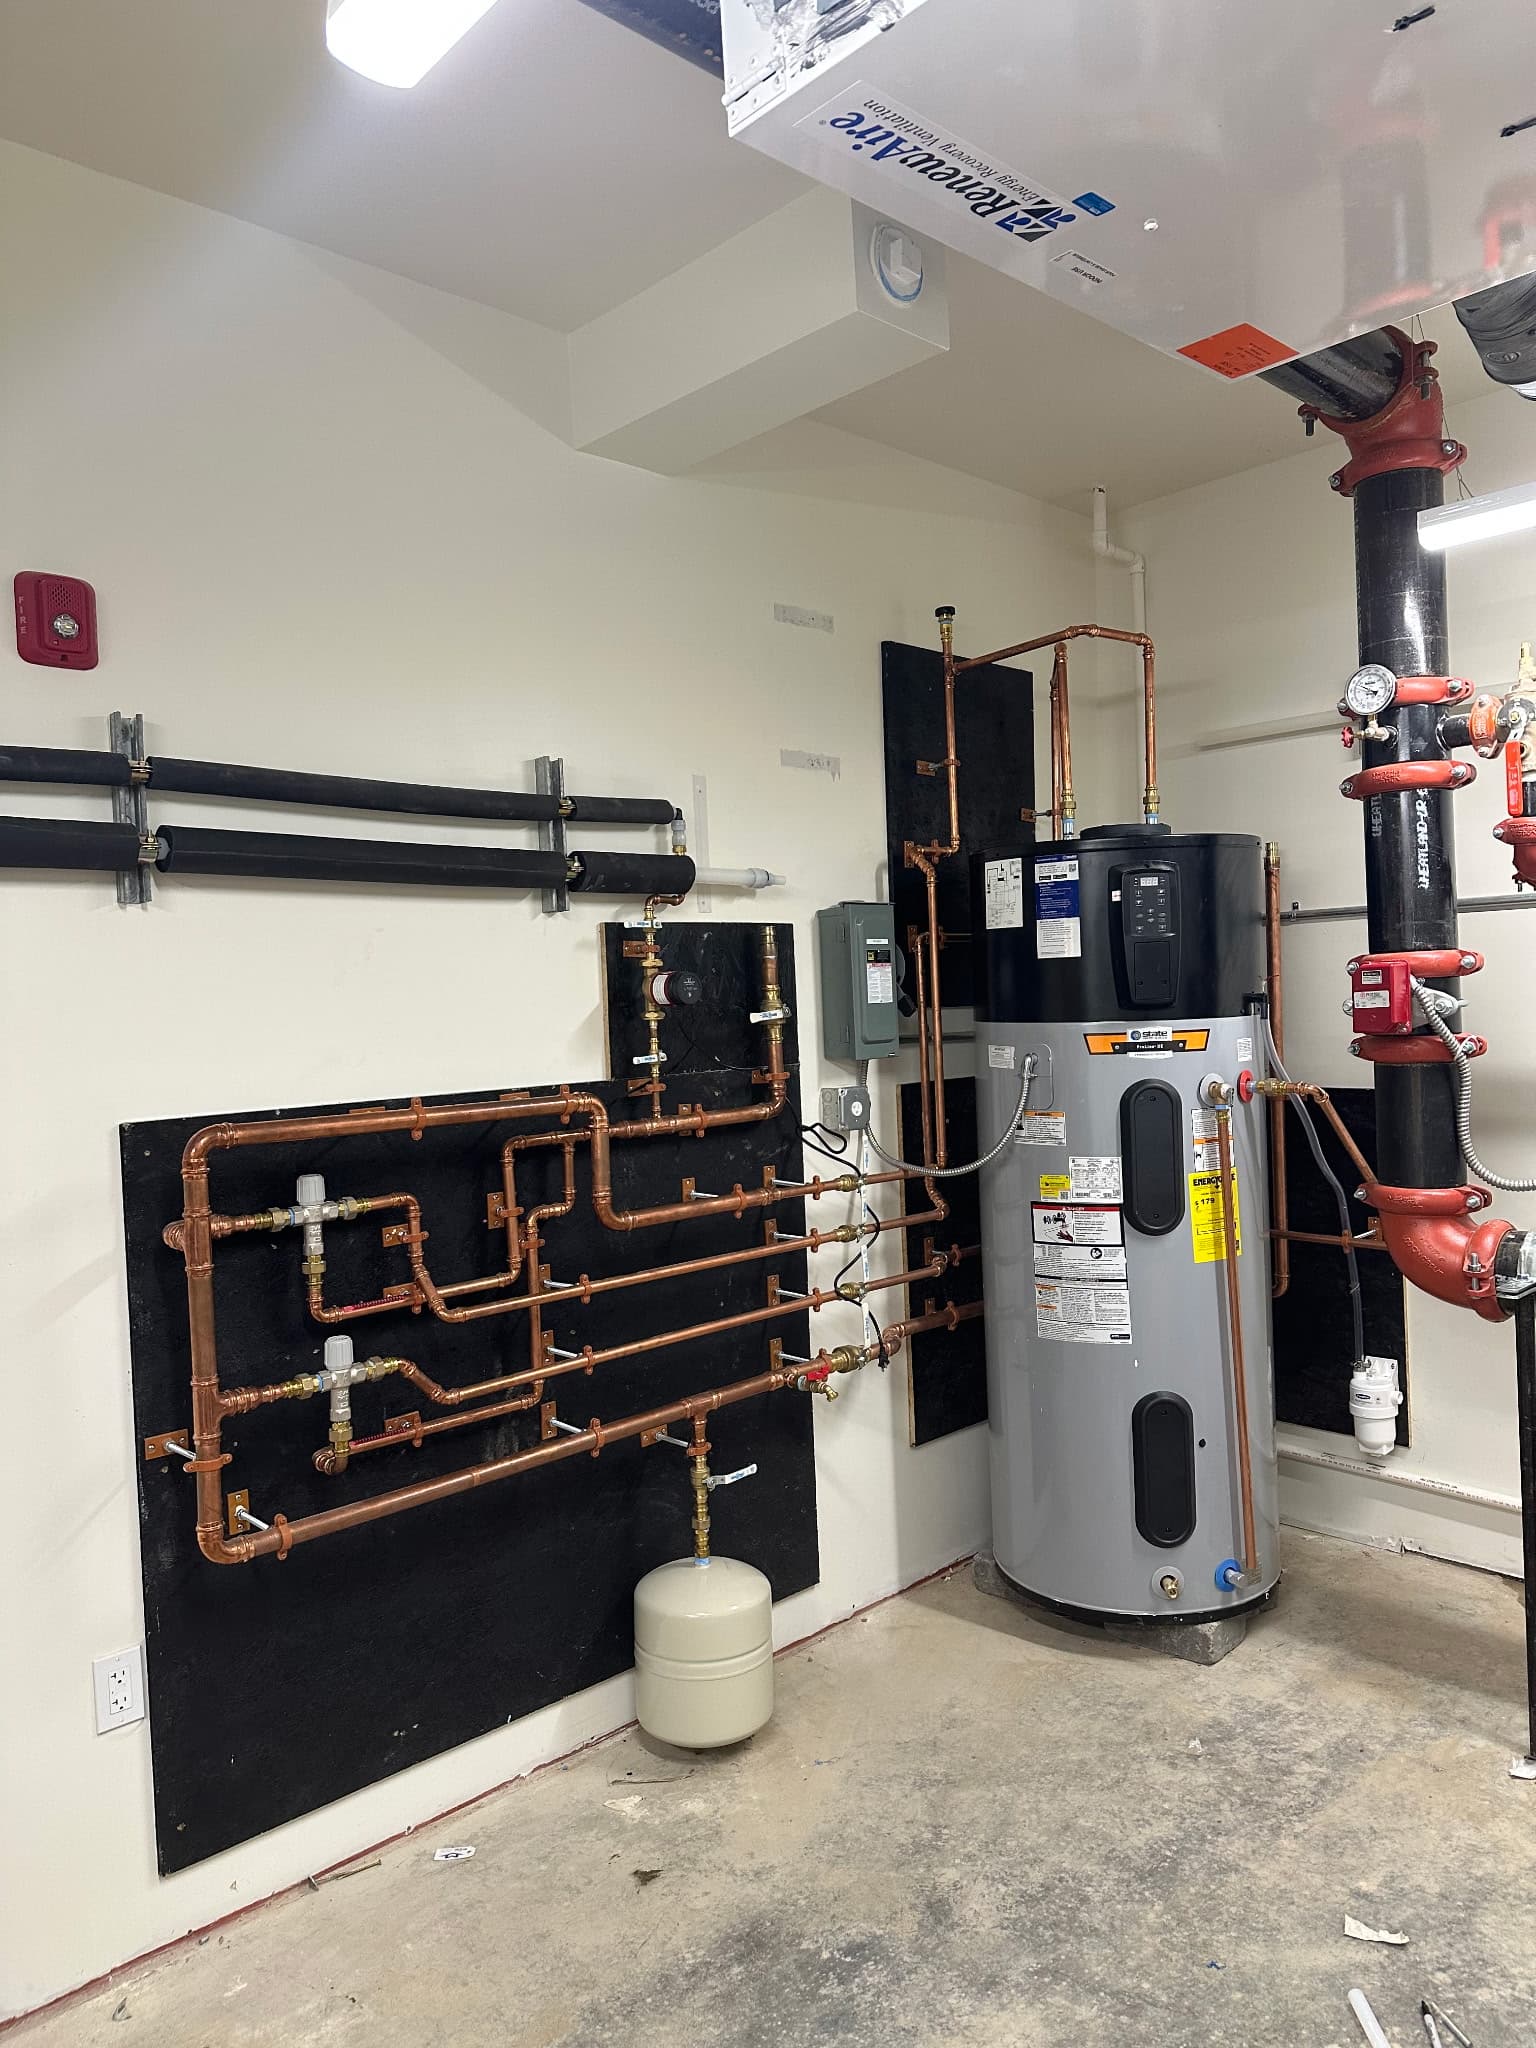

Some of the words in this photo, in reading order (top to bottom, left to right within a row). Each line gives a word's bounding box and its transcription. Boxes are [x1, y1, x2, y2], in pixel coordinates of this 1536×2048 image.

[863, 97, 941, 147] Ventilation
[830, 112, 1021, 218] RenewAire
[938, 142, 998, 178] Recovery
[994, 174, 1040, 202] Energy
[18, 596, 27, 634] FIRE
[1142, 1030, 1169, 1038] state
[1200, 1197, 1216, 1205] 179
